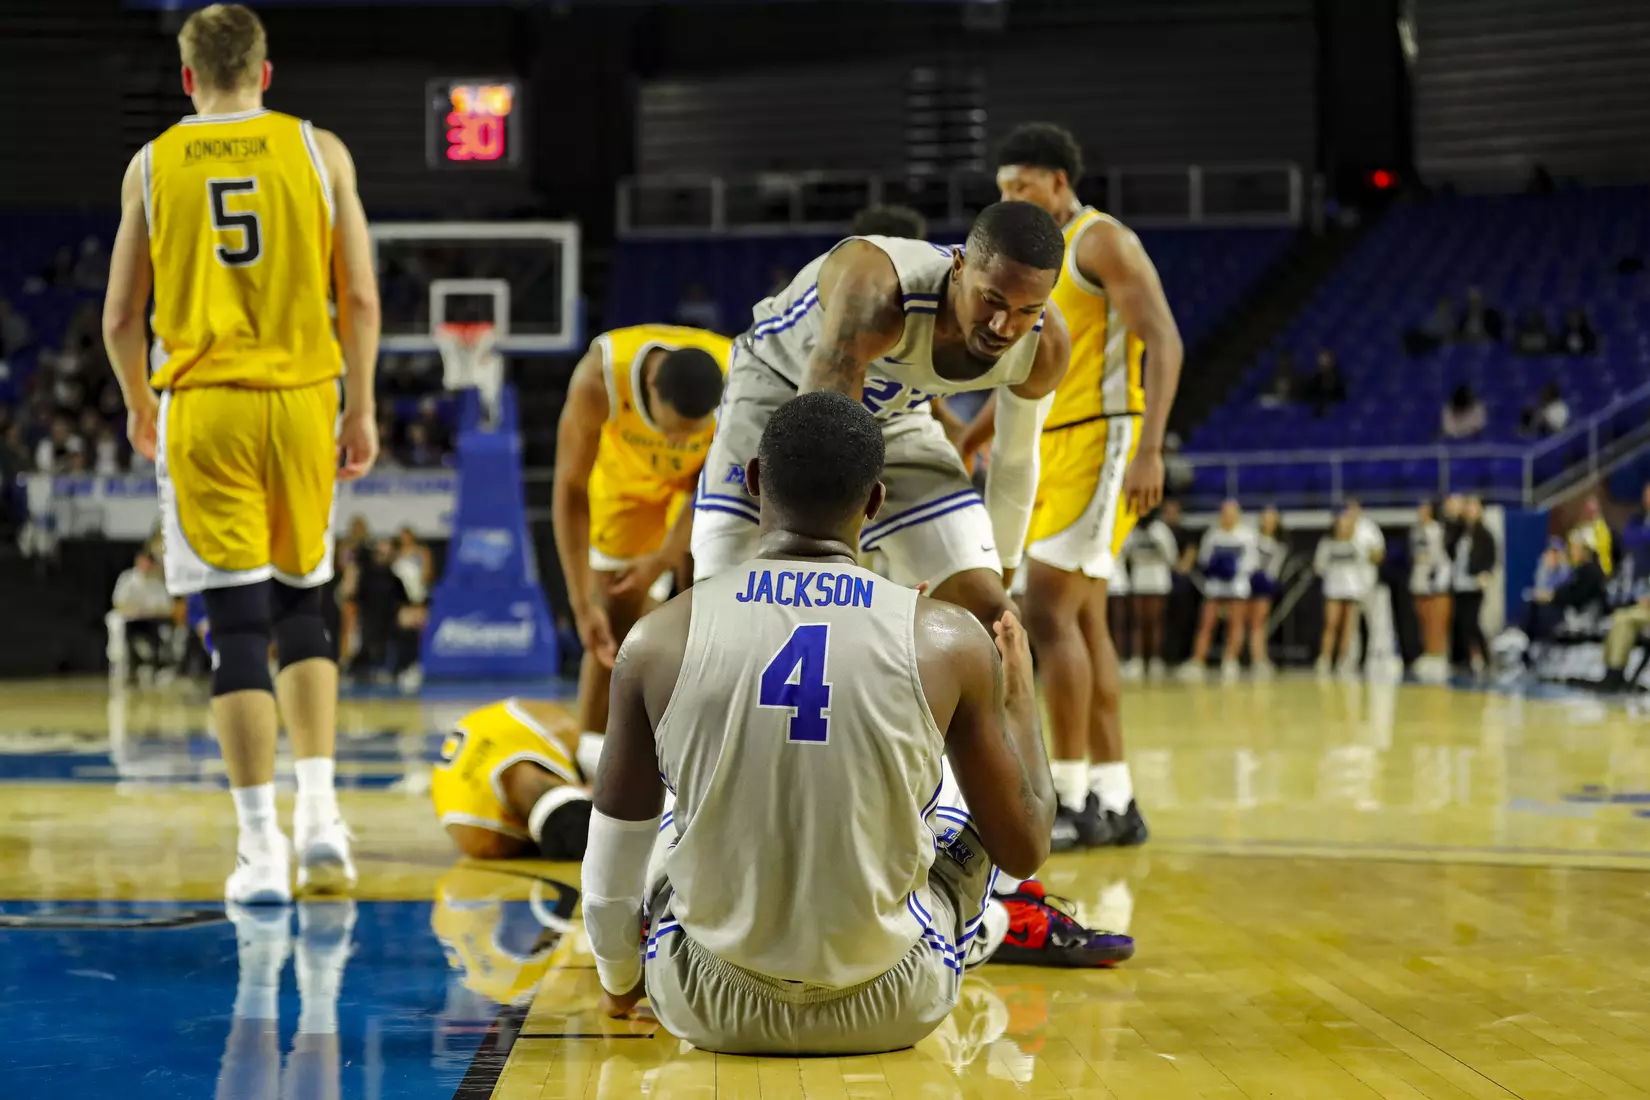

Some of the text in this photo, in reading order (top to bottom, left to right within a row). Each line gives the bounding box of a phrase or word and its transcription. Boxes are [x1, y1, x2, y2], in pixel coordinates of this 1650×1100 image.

[184, 136, 270, 161] KONONTSUK
[206, 176, 264, 268] 5
[735, 570, 874, 608] JACKSON
[756, 621, 834, 746] 4
